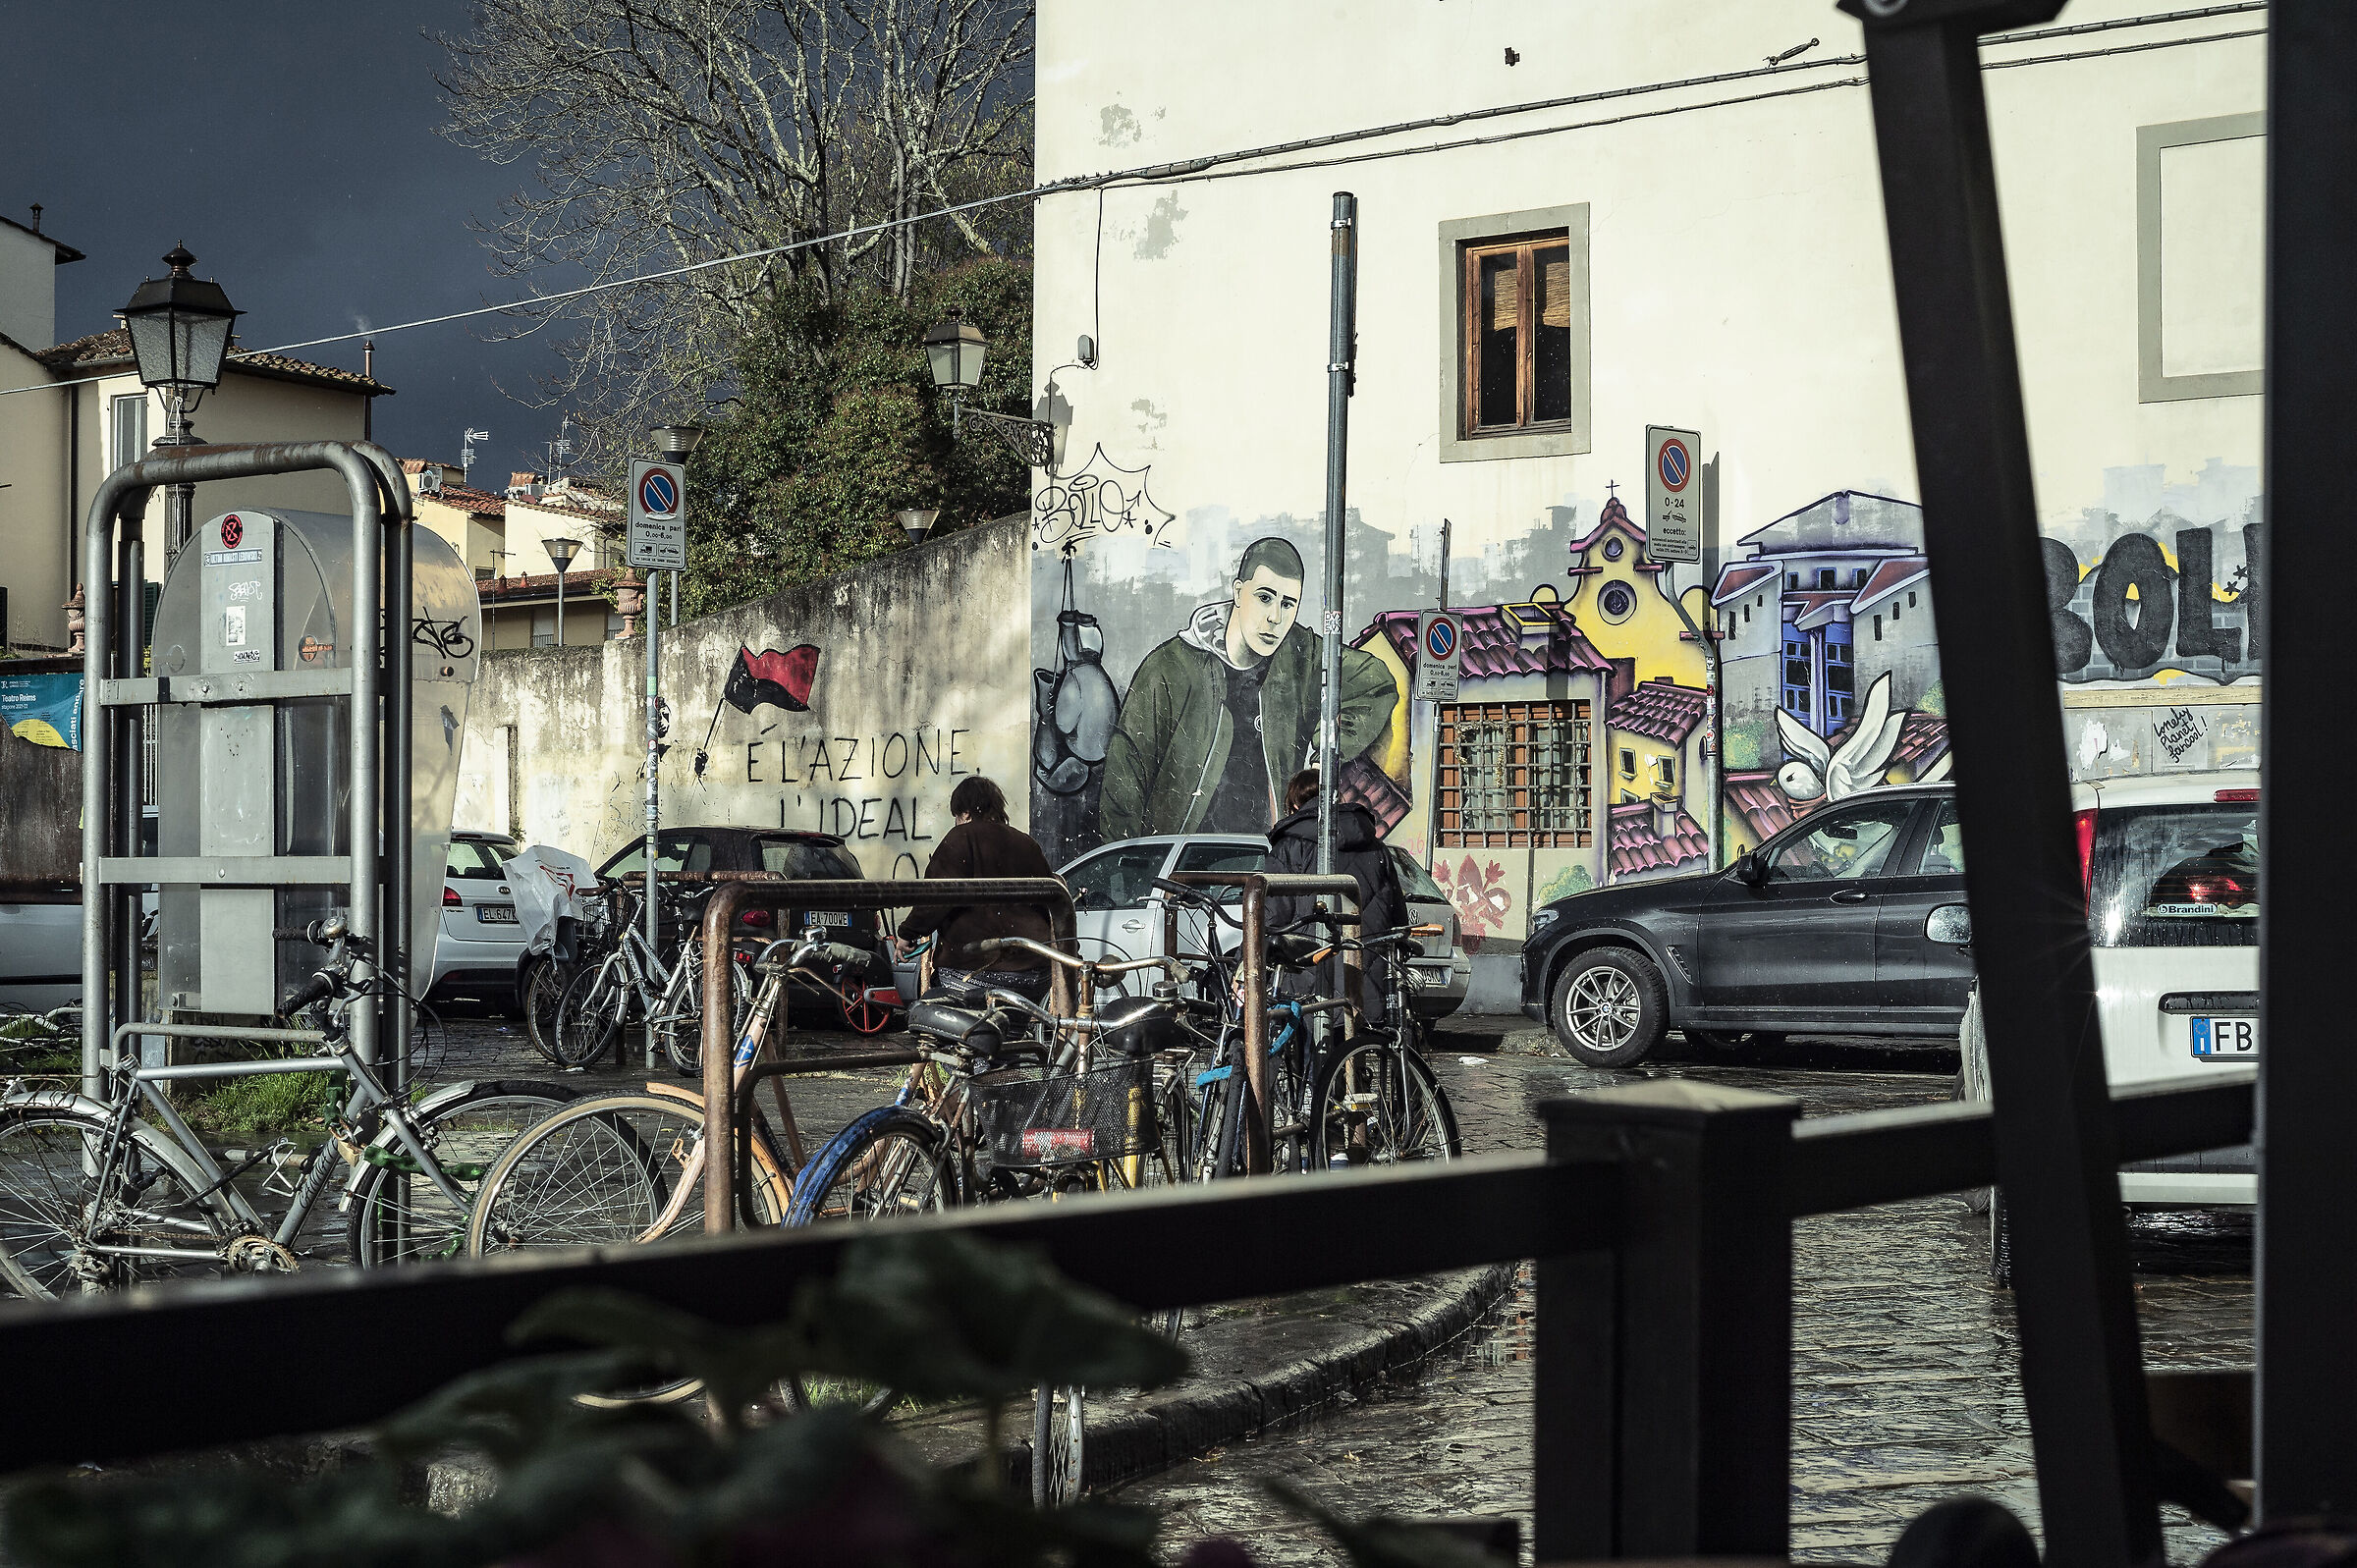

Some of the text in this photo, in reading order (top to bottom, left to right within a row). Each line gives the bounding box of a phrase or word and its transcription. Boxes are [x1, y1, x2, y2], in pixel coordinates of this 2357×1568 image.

[635, 521, 665, 530] domenica
[19, 693, 36, 702] Reims
[2168, 905, 2215, 914] Brandini
